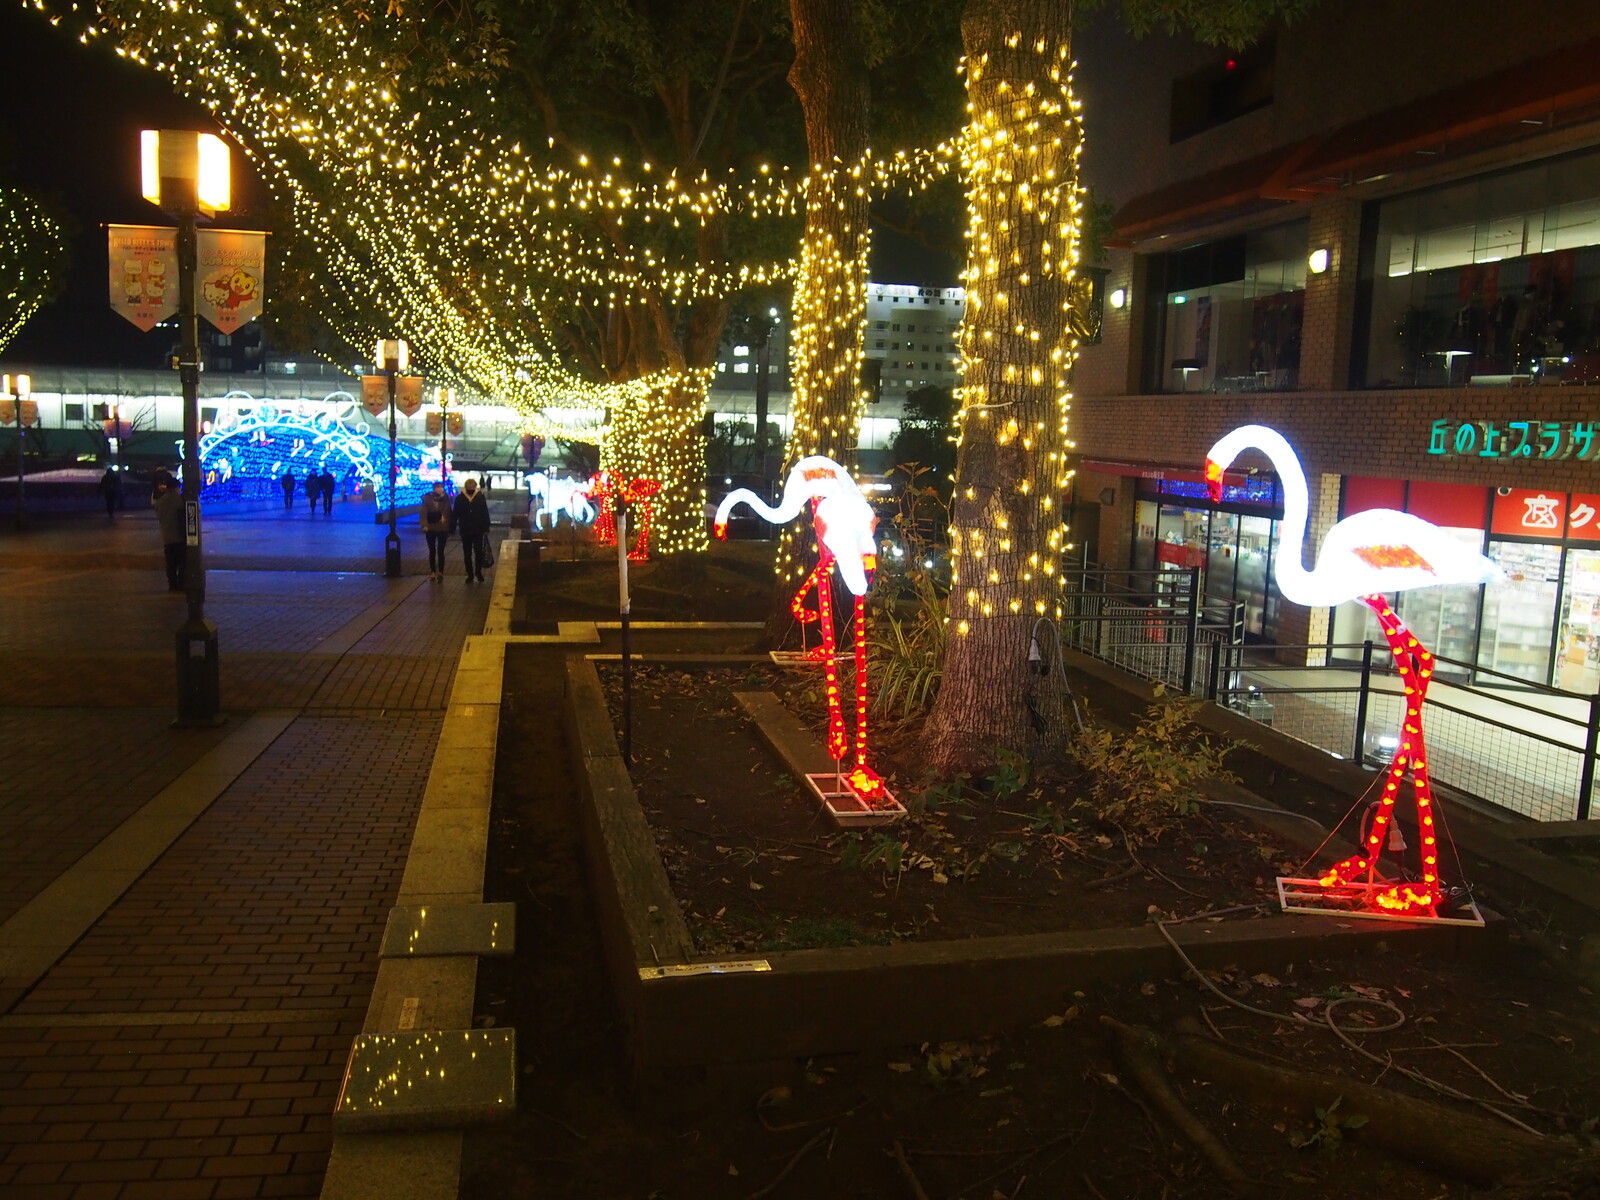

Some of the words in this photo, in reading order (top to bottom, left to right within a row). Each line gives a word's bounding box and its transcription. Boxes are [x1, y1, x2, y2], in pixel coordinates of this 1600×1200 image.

[1427, 419, 1600, 458] 丘の上プラザ
